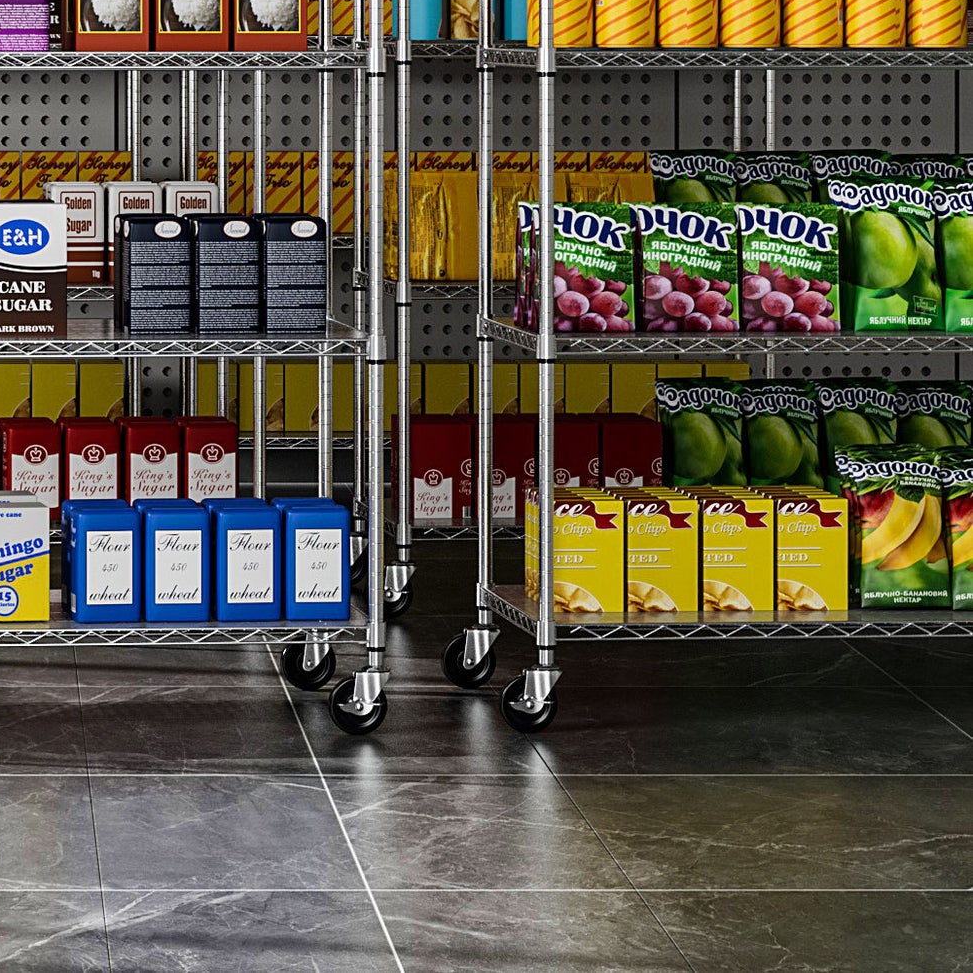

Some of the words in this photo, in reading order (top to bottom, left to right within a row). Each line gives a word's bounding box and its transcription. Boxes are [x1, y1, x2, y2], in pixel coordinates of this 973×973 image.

[27, 155, 77, 173] Honey
[123, 197, 150, 209] Golden
[180, 197, 207, 209] Golden
[2, 229, 43, 246] E&H
[554, 240, 605, 257] БЛУЧНО-
[651, 241, 710, 257] ЯБЛУЧНО-
[751, 241, 811, 257] ЯБЛУЧНО-
[869, 315, 906, 325] ЯБЛУЧНИЙ
[908, 317, 932, 326] НЕКТАР
[73, 470, 113, 482] King's
[134, 470, 174, 482] King's
[192, 470, 231, 482] King's
[71, 480, 114, 497] Sugar
[132, 480, 175, 497] Sugar
[190, 480, 233, 497] Sugar
[562, 522, 593, 536] Chips
[638, 521, 667, 536] Chips
[712, 522, 743, 536] Chips
[787, 522, 817, 535] Chips
[89, 534, 130, 553] Flour
[157, 533, 200, 552] Flour
[229, 532, 272, 552] Flour
[297, 532, 340, 552] Flour
[89, 585, 130, 601] wheat
[158, 585, 198, 601] wheat
[230, 584, 270, 600] wheat
[298, 584, 338, 600] wheat
[864, 590, 948, 599] ЯБЛУЧНО-БАНАНОВИЙ
